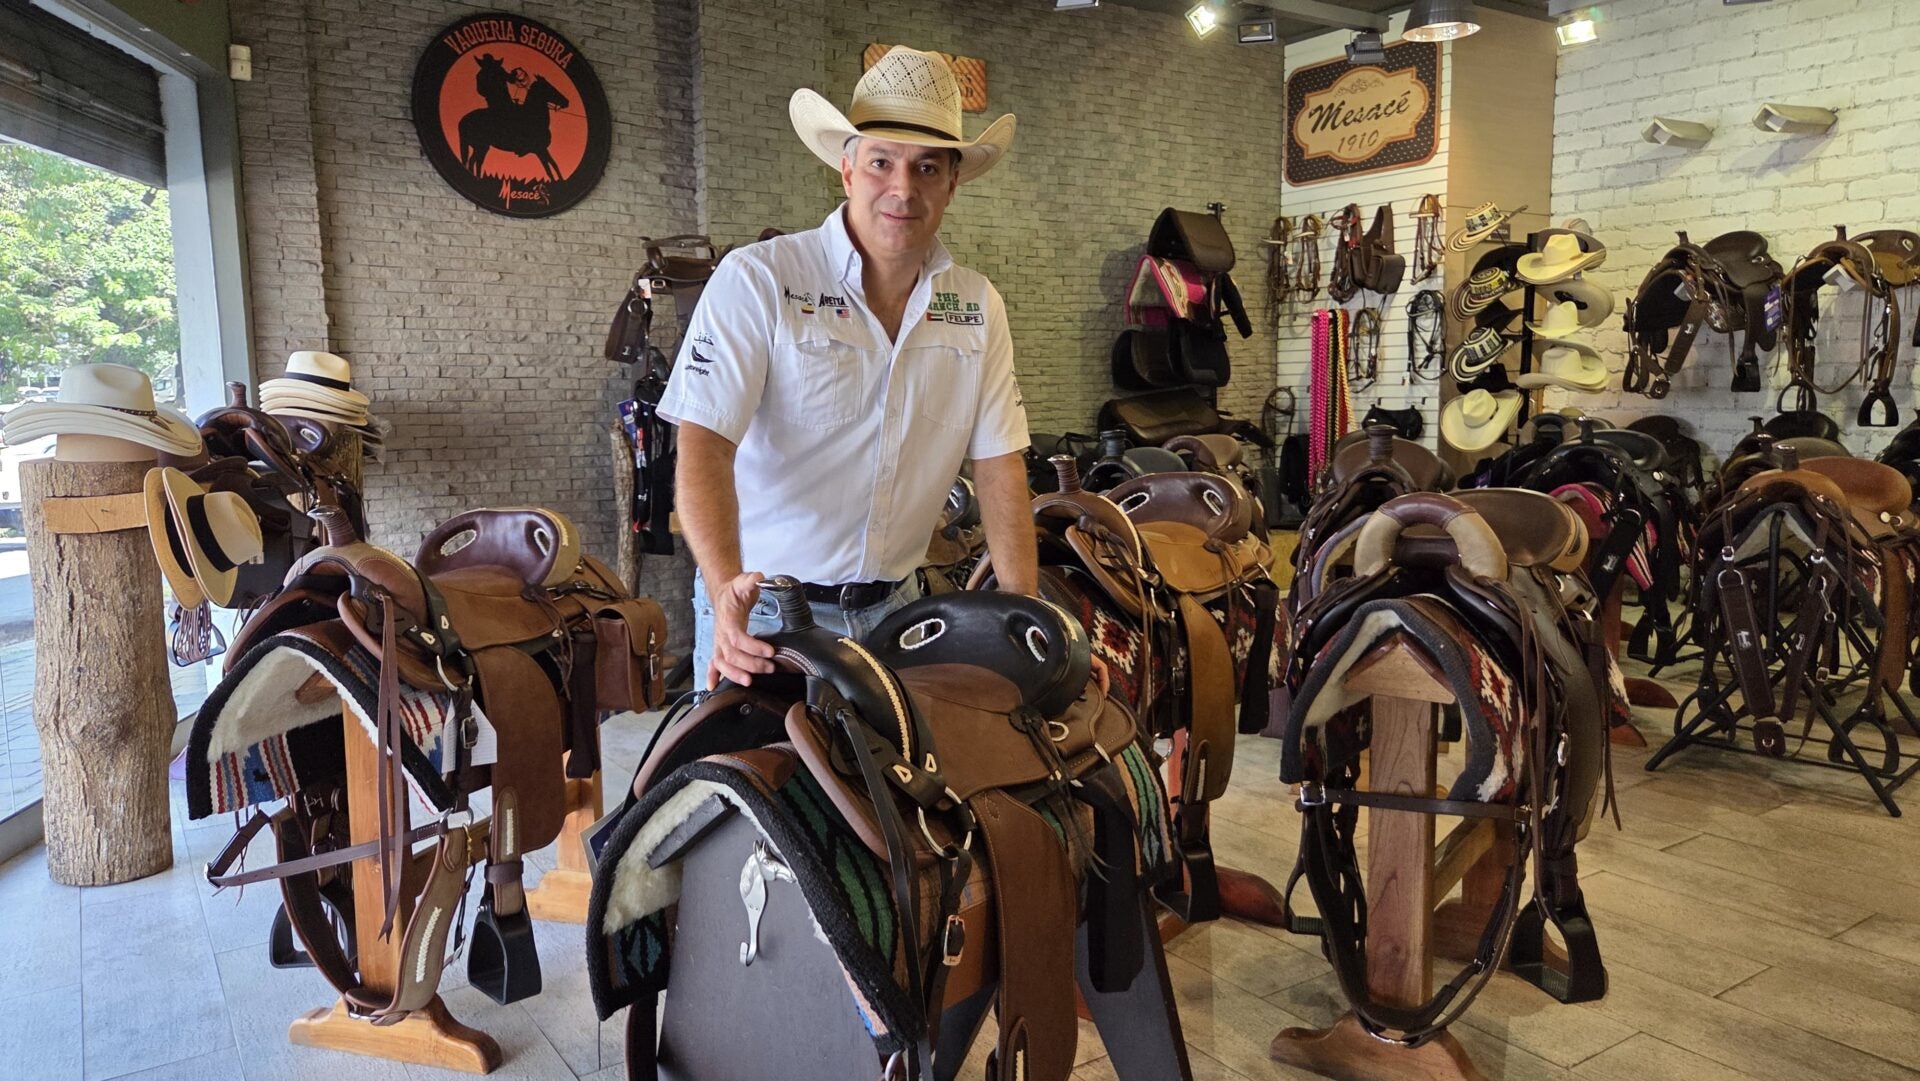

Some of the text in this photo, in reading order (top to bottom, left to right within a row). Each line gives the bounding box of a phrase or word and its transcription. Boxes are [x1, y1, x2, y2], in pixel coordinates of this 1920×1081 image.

[444, 20, 574, 69] VAQUERIA SEGURA
[1308, 91, 1411, 134] Mesacé
[1337, 129, 1381, 154] 1910
[935, 292, 960, 304] THE
[949, 315, 982, 324] FELIPE
